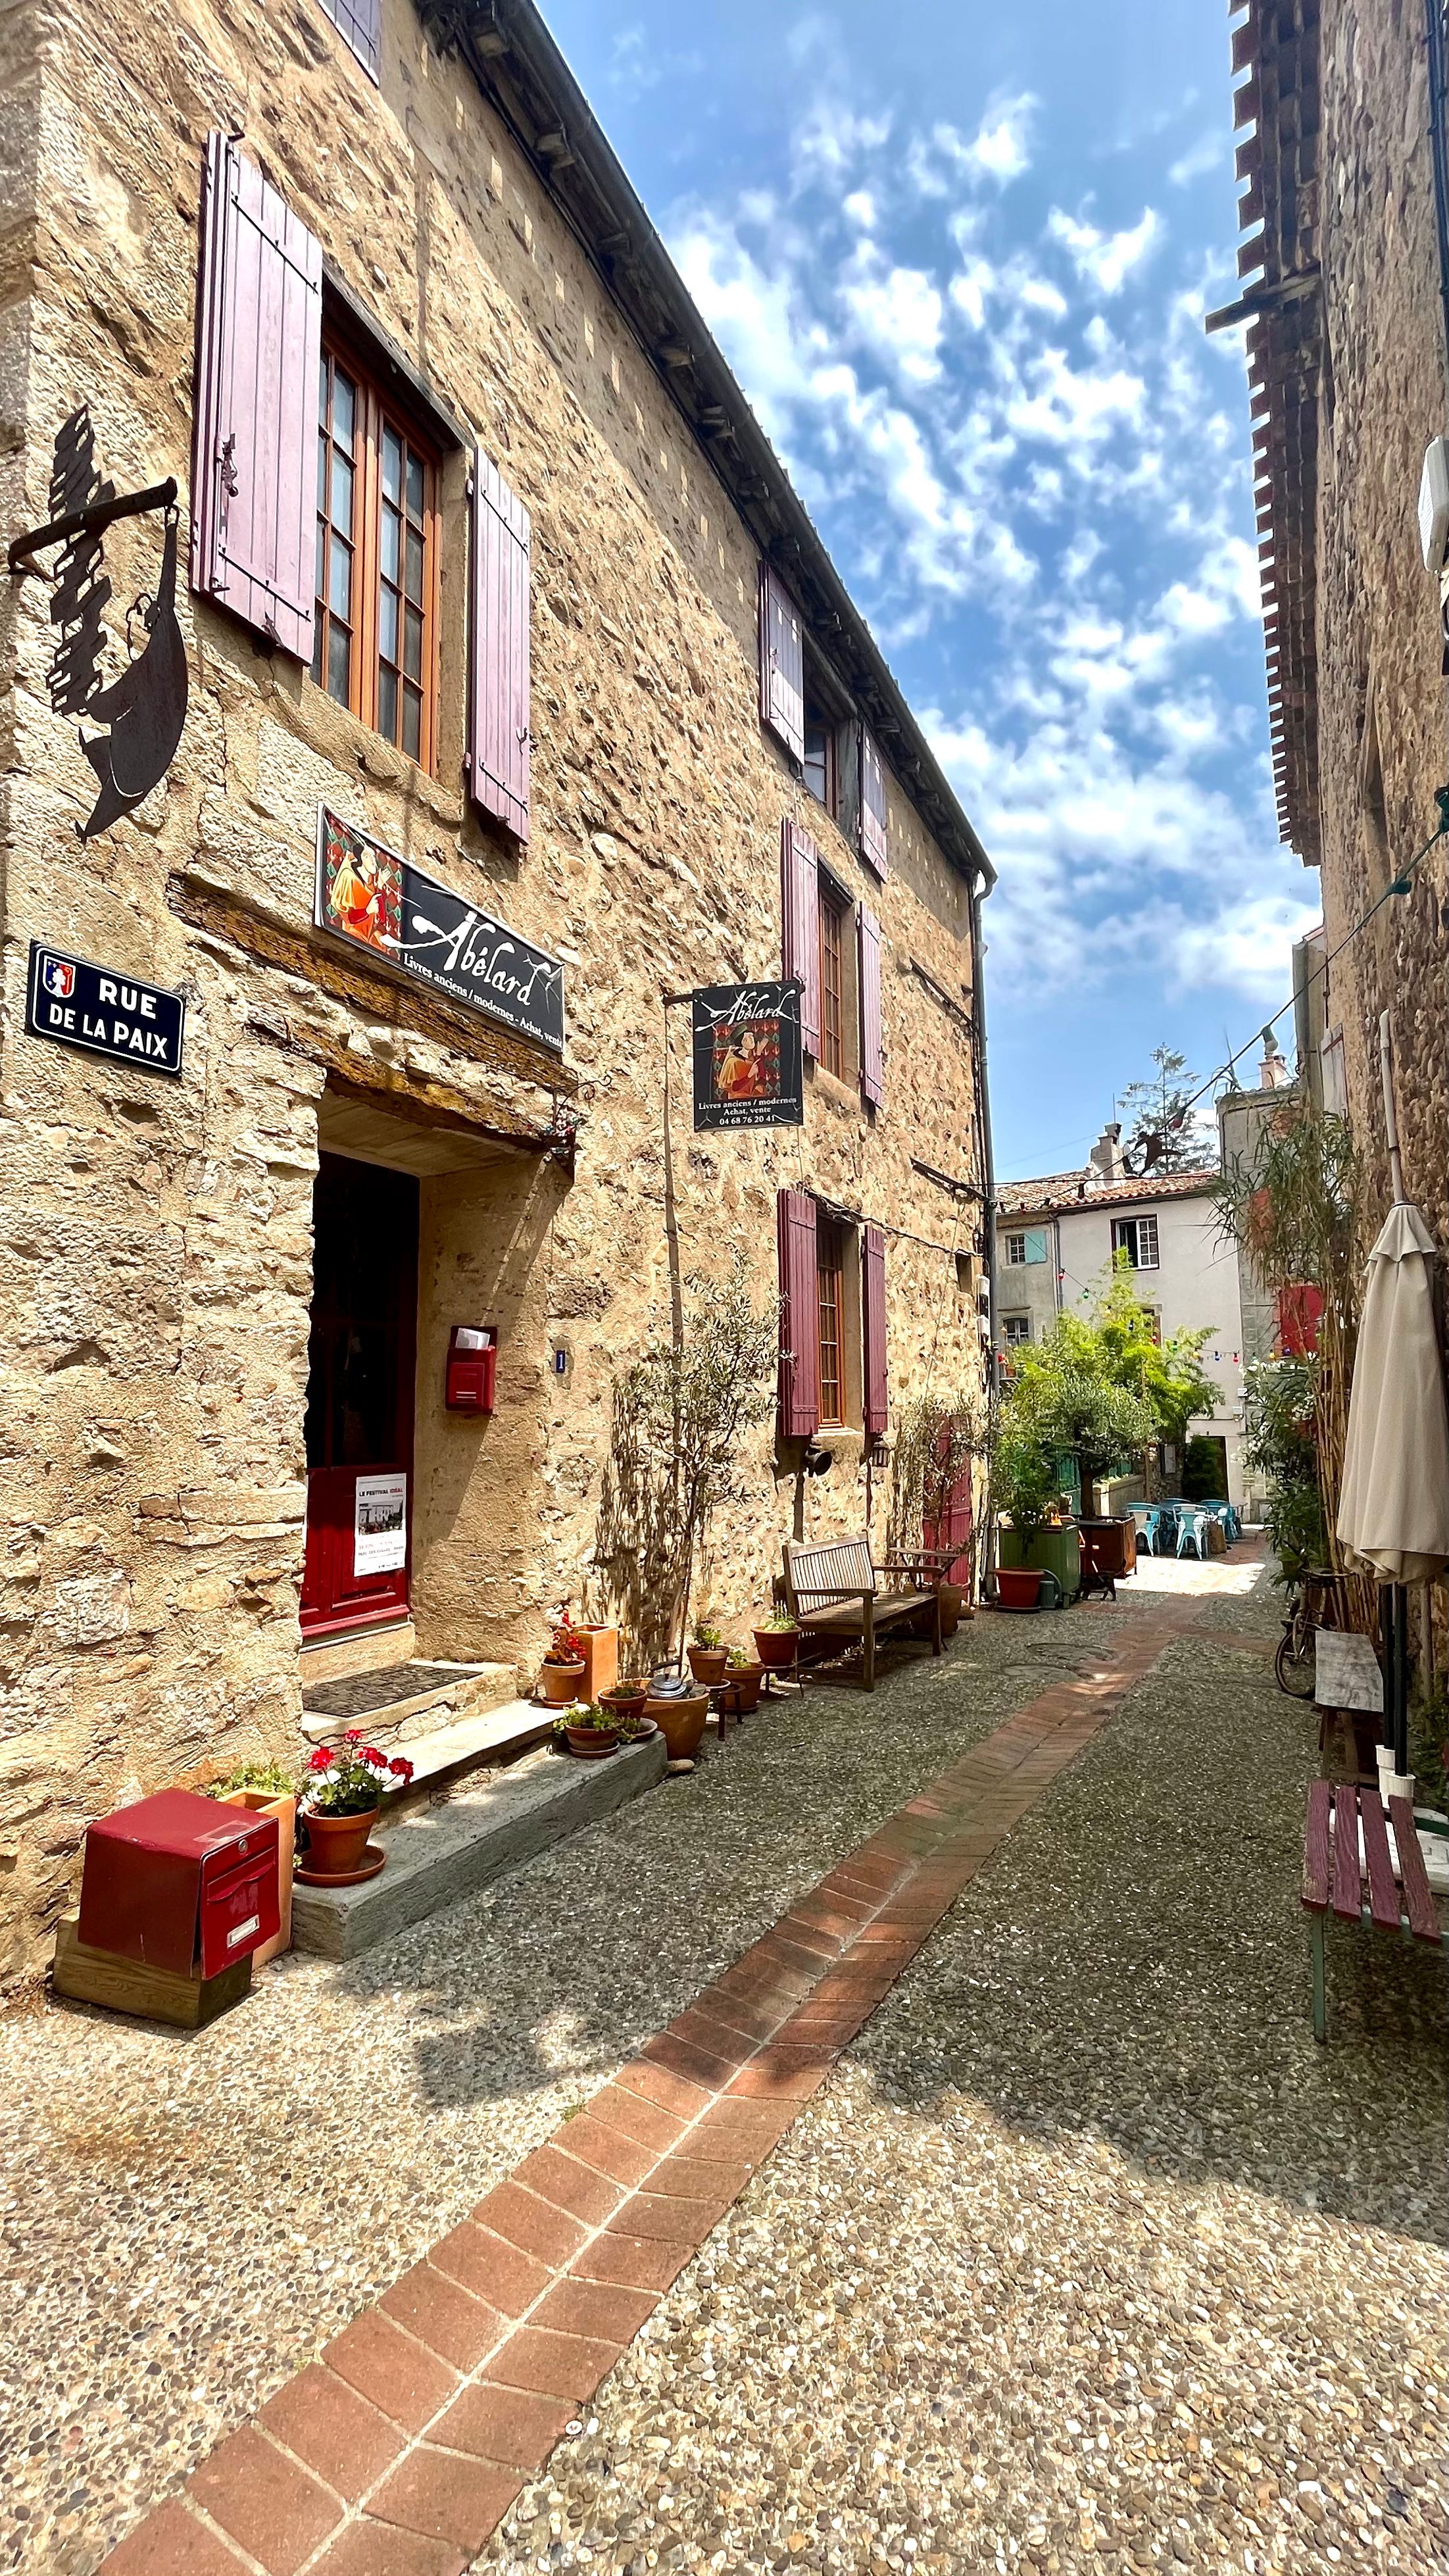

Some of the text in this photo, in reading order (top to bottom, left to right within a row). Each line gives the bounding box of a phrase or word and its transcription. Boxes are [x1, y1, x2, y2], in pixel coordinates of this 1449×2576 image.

[380, 911, 551, 1006] Abélard
[99, 978, 157, 1019] RUE
[403, 953, 432, 979] Livres
[434, 973, 468, 997] anciens
[468, 989, 474, 1000] /
[474, 992, 514, 1023] modernes
[520, 1017, 543, 1039] Achat,
[695, 989, 796, 1032] Abélard
[49, 1003, 168, 1060] DE LA PAIX
[558, 1354, 564, 1369] 1
